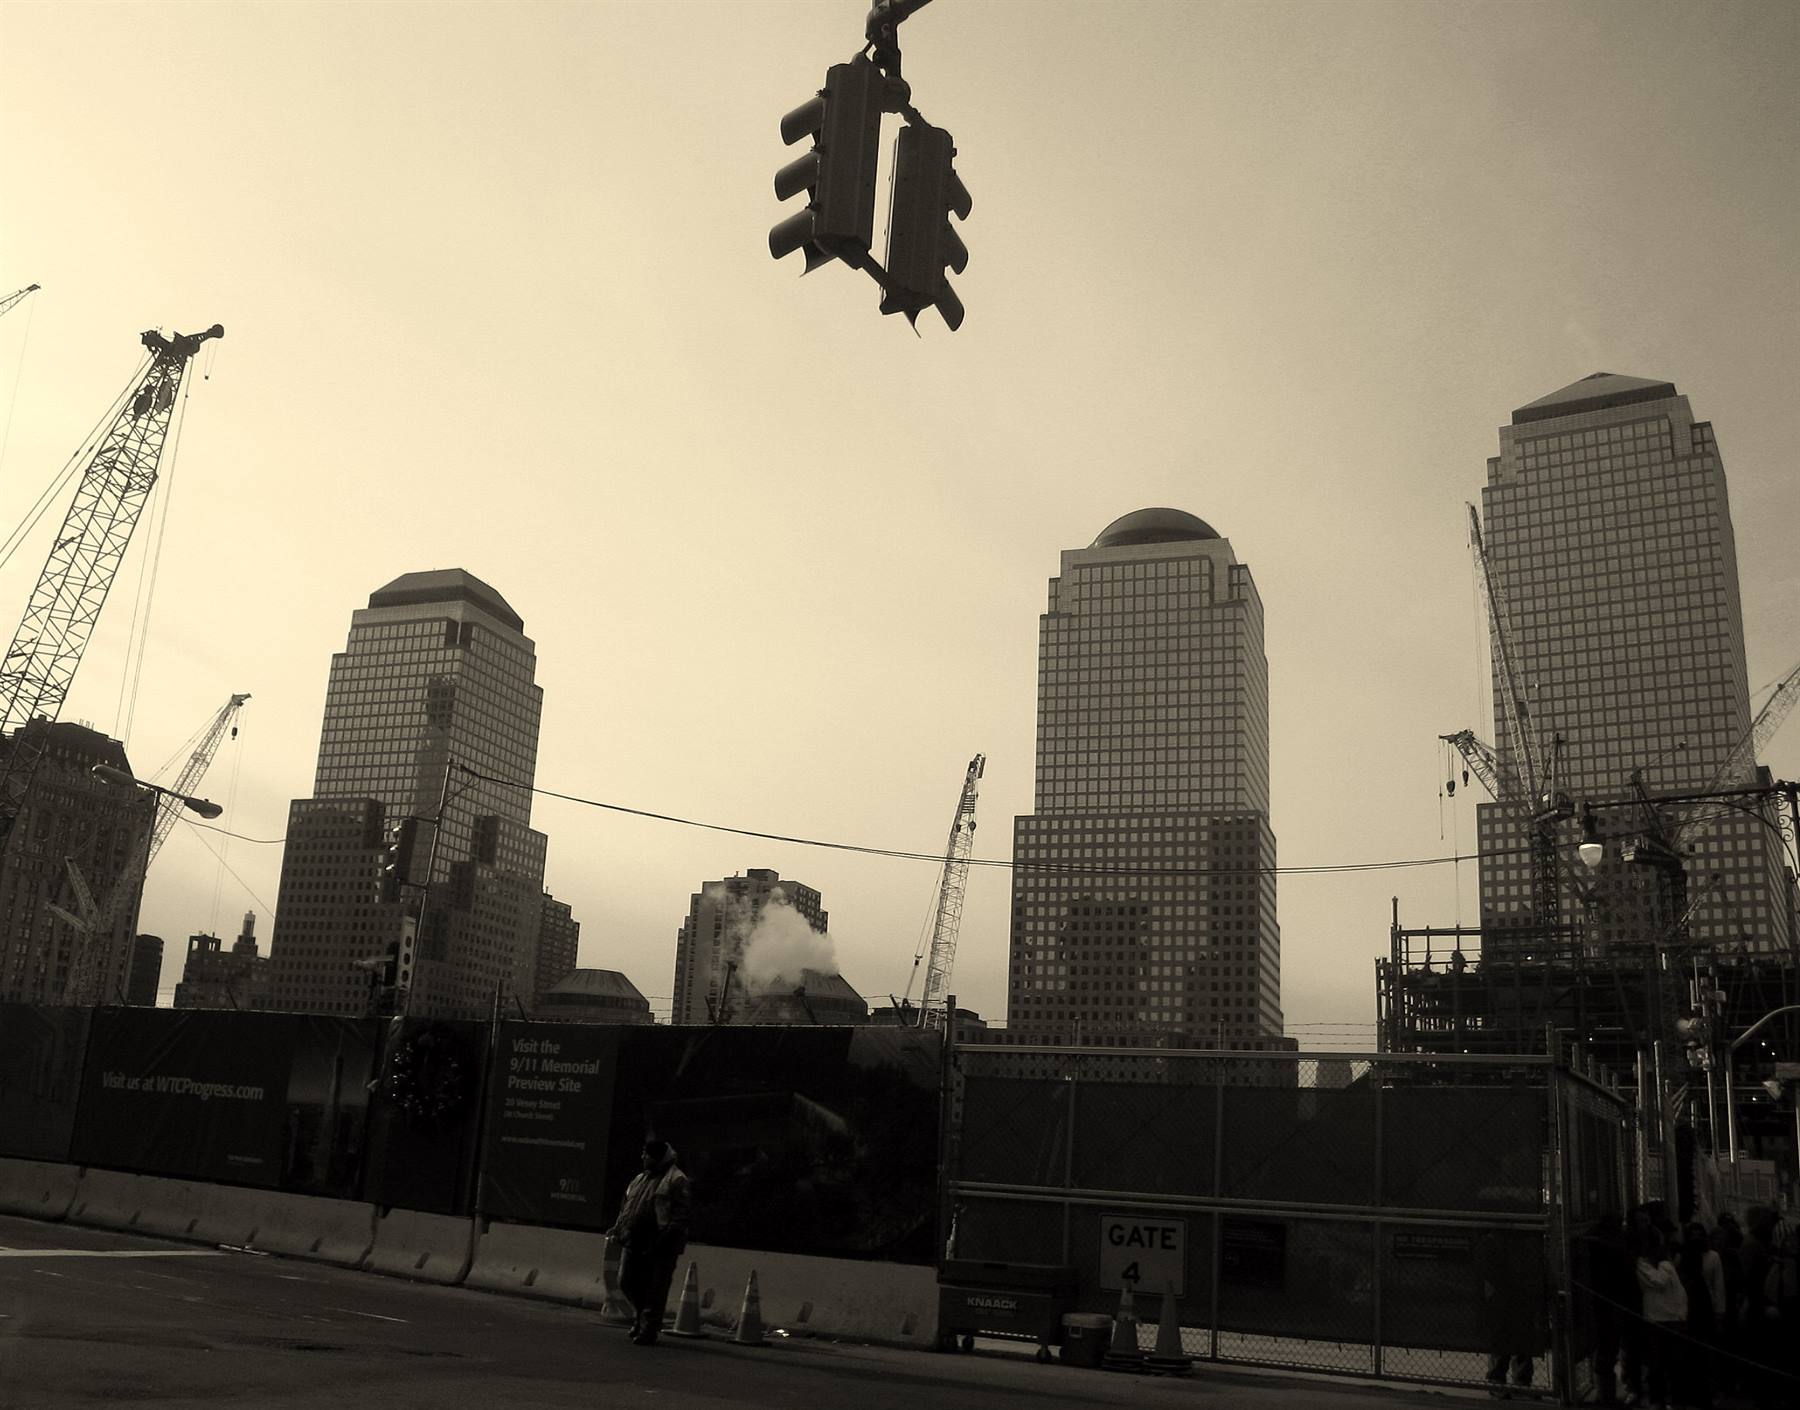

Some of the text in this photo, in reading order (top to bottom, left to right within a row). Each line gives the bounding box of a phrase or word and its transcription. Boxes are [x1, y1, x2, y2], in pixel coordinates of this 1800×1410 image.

[511, 1038, 560, 1054] Visit the
[510, 1056, 600, 1075] 9/11 Memorial
[102, 1071, 264, 1101] Visit us at WTCProgress.com
[507, 1075, 582, 1093] Preview Site
[1108, 1224, 1177, 1250] GATE
[1121, 1262, 1140, 1284] 4
[967, 1296, 1017, 1310] KNAACK
